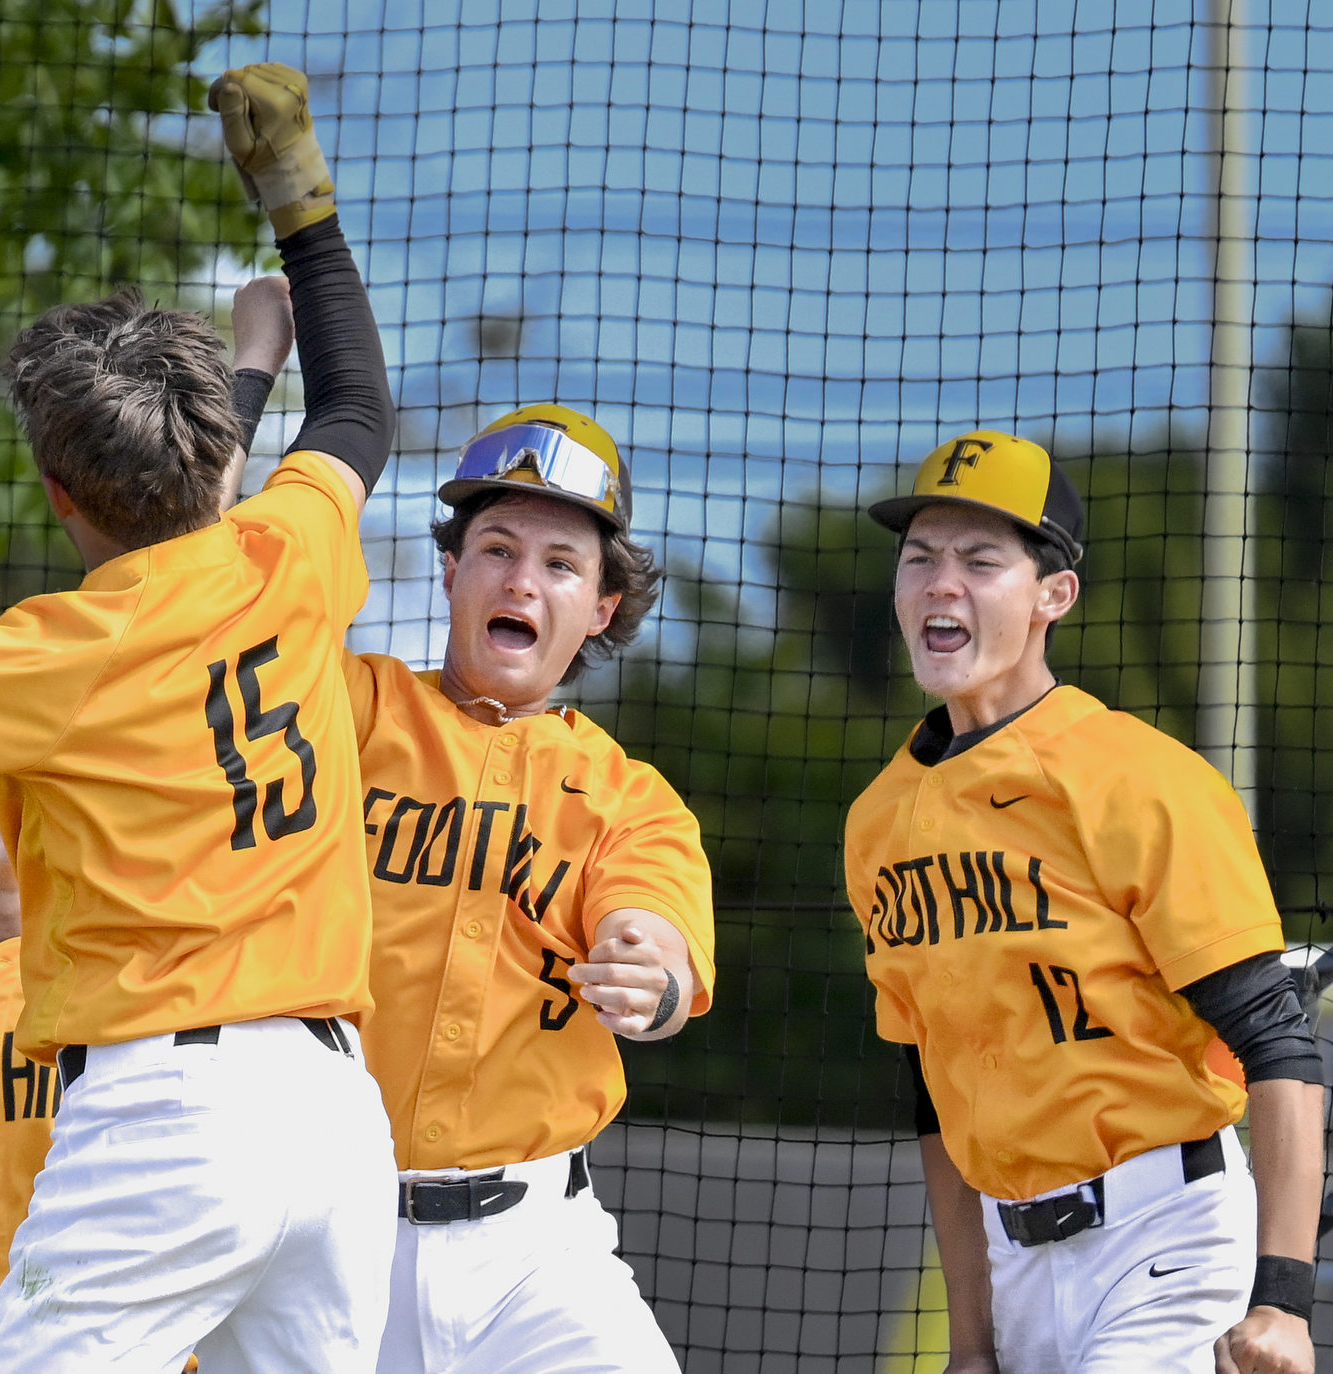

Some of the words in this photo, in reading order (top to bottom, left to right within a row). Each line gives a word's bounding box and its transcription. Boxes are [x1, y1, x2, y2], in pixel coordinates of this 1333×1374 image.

[937, 439, 995, 487] F
[205, 634, 317, 851] 15
[1029, 962, 1115, 1045] 12
